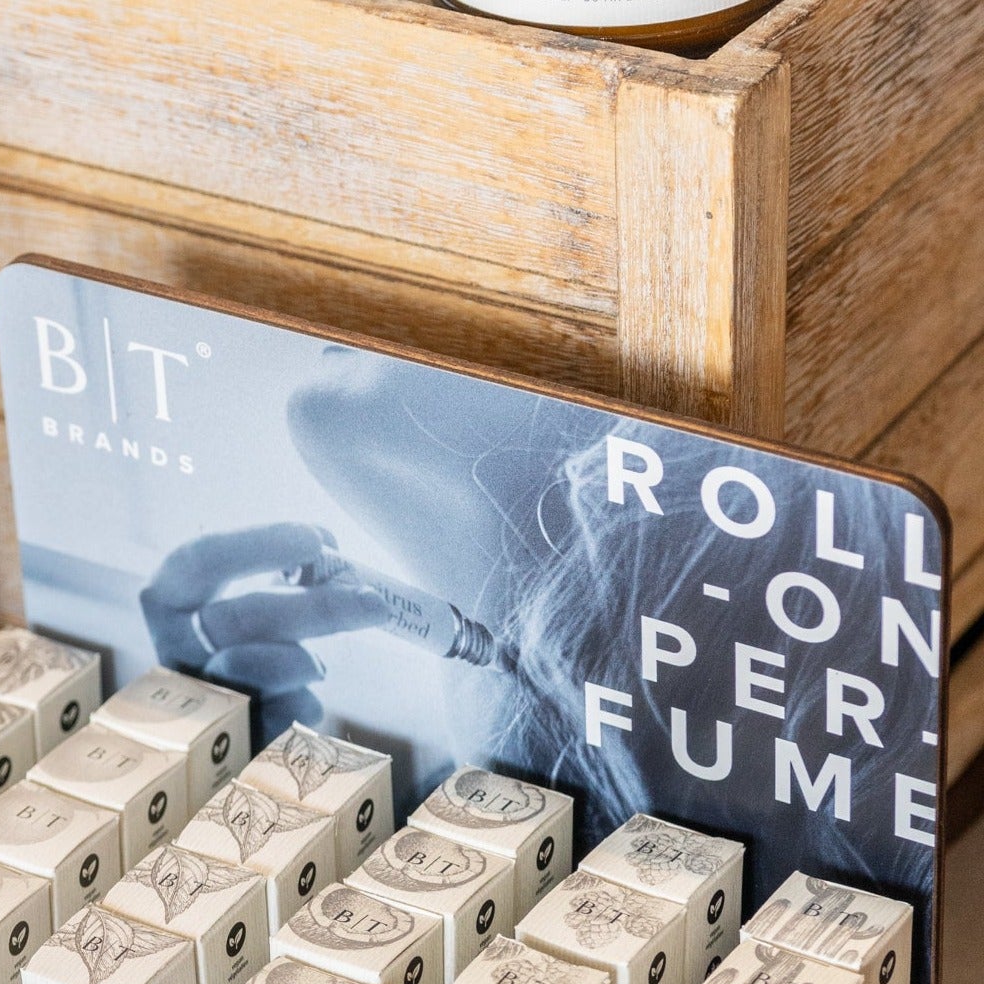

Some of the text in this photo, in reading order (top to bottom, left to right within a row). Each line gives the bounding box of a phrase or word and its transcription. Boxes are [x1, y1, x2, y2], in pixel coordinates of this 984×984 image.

[42, 416, 195, 475] BRANDS
[606, 434, 941, 591] ROLL
[584, 681, 937, 848] FUME
